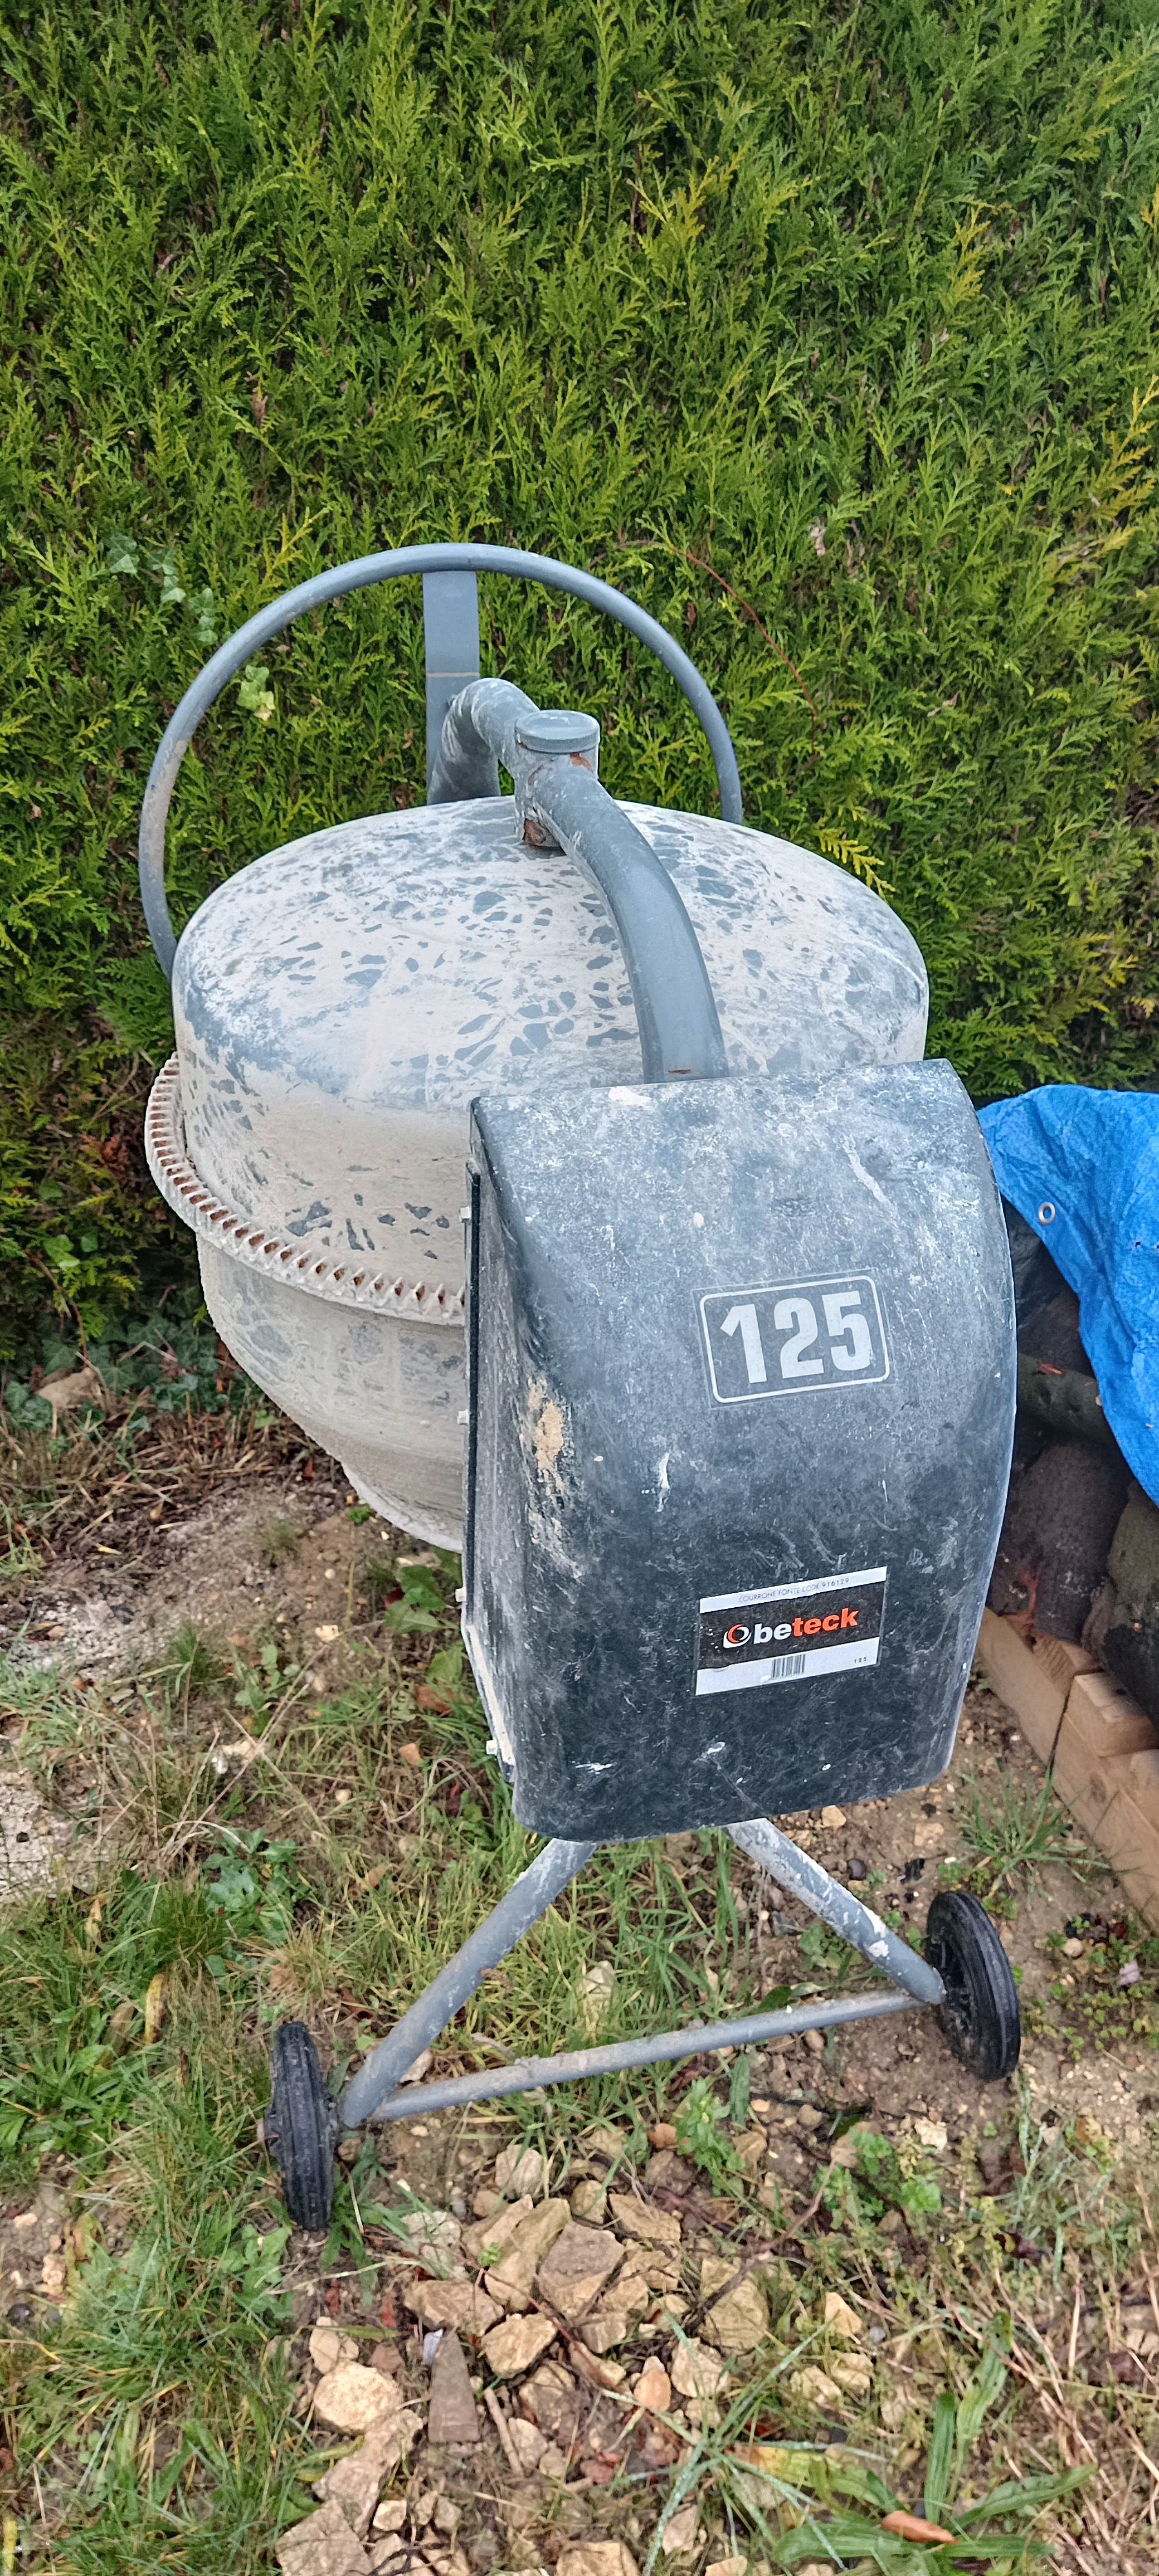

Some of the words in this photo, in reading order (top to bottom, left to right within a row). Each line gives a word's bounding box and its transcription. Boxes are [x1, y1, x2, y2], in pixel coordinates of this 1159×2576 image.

[719, 1290, 873, 1384] 125
[778, 1587, 800, 1596] FONTE
[802, 1583, 820, 1592] CODE
[822, 1578, 849, 1587] 916129
[753, 1607, 859, 1644] beteck
